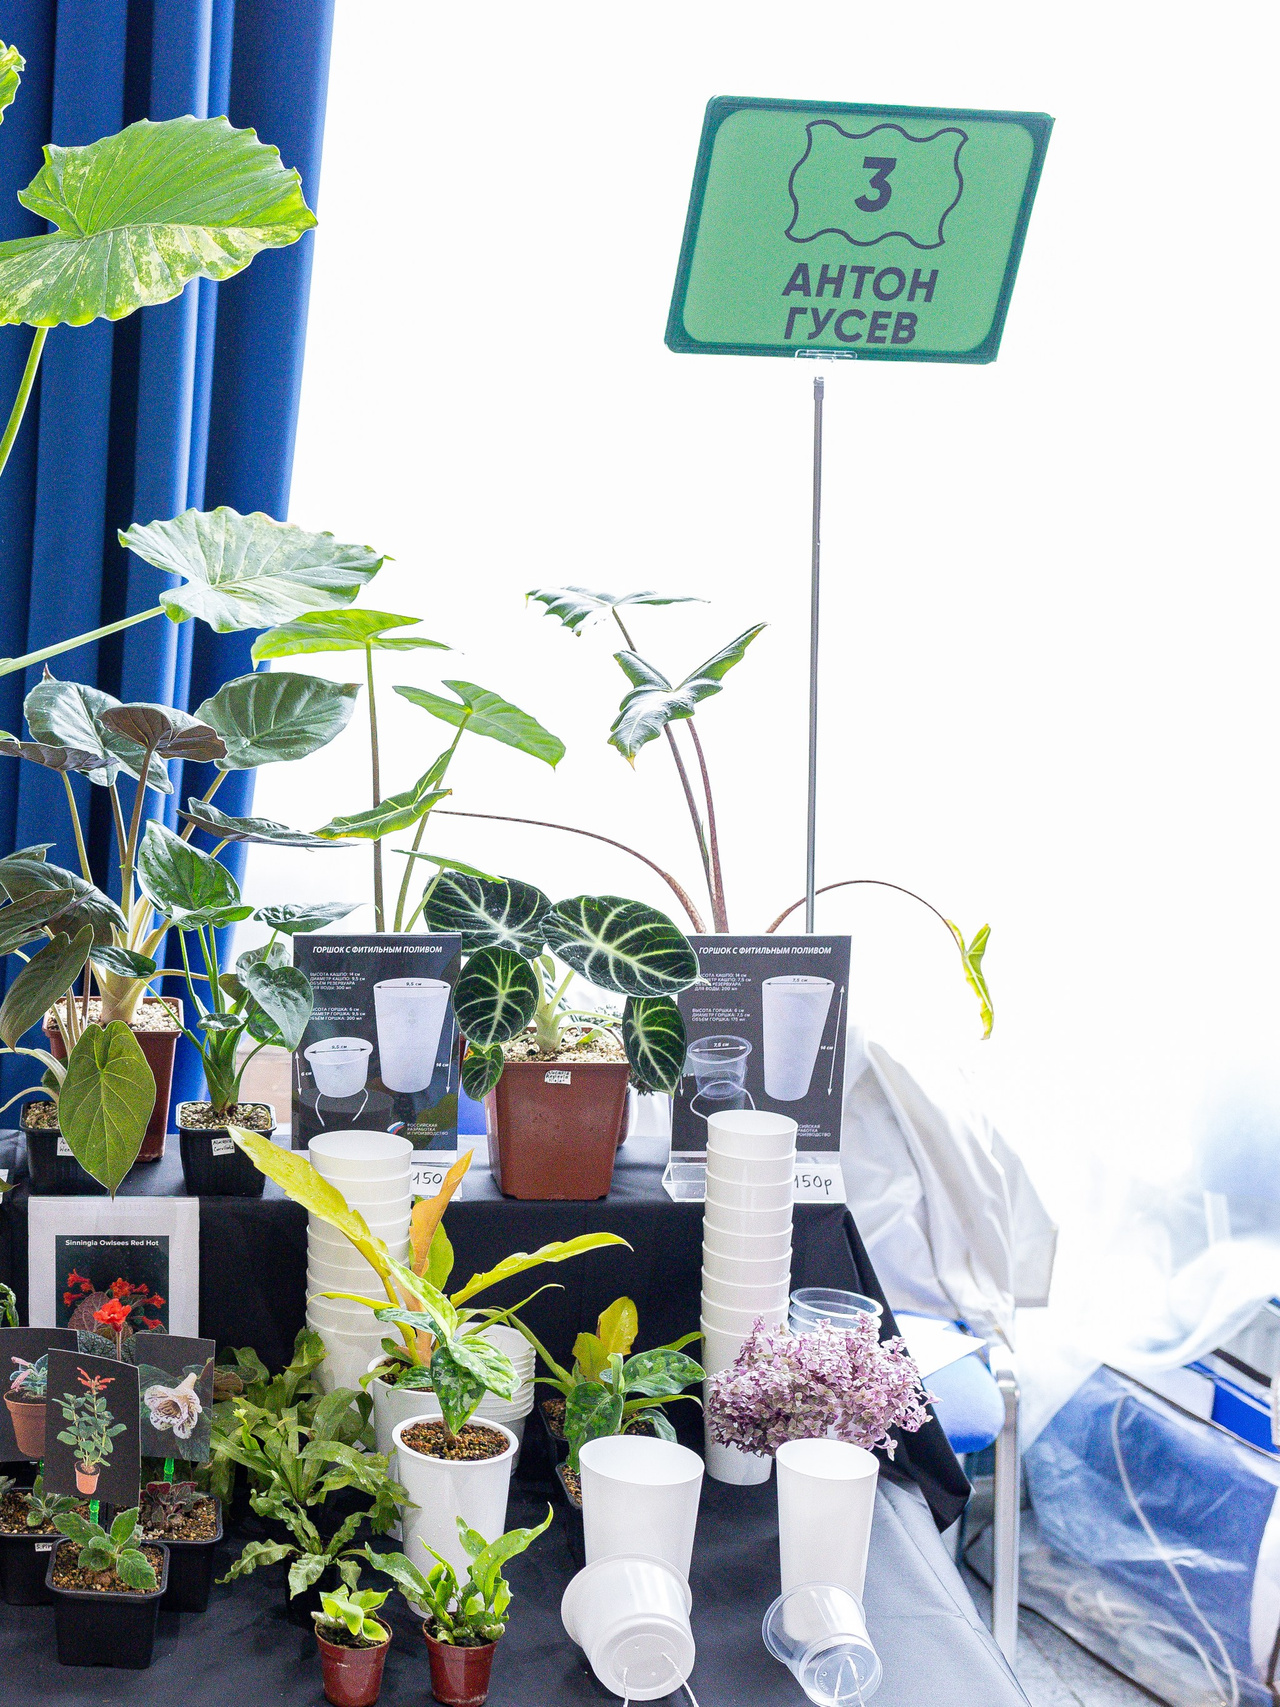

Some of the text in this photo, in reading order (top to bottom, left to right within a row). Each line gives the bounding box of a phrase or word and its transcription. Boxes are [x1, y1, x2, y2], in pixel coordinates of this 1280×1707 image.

[853, 156, 898, 213] 3
[781, 262, 940, 303] АНТОН
[783, 306, 919, 345] ГУСЕВ
[312, 945, 443, 954] ГОРШОК С ФИТИЛЬНЫМ ПОЛИВОМ
[698, 947, 732, 955] ГОРШОК
[738, 947, 790, 955] ФИТИЛЬНЫМ
[790, 947, 832, 955] ПОЛИВОМ
[65, 1239, 98, 1247] Sinningia
